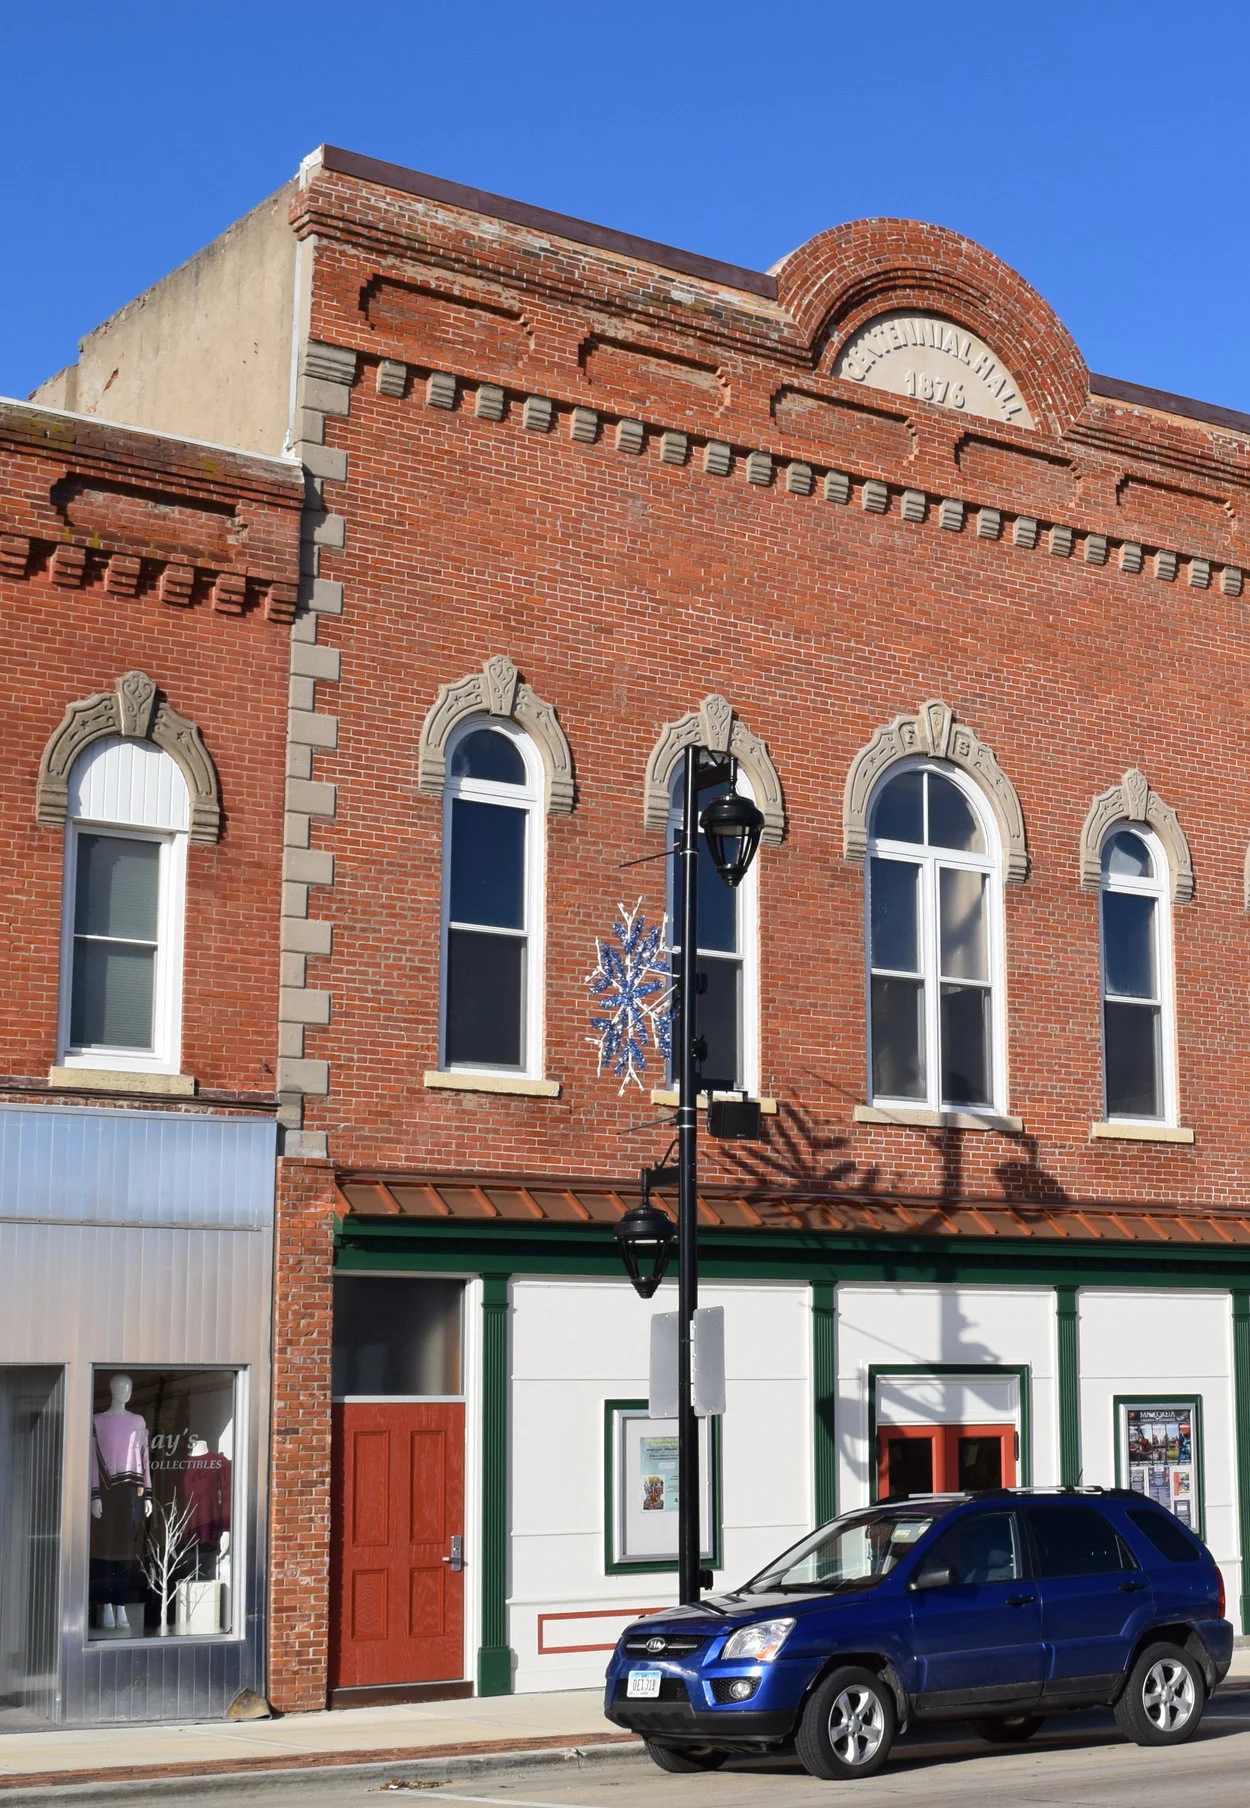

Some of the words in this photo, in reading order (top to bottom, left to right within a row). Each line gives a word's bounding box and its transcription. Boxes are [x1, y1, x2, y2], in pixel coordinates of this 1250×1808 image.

[842, 317, 972, 382] CENTENNIAL
[971, 351, 1023, 422] HALL
[904, 369, 966, 409] 1876
